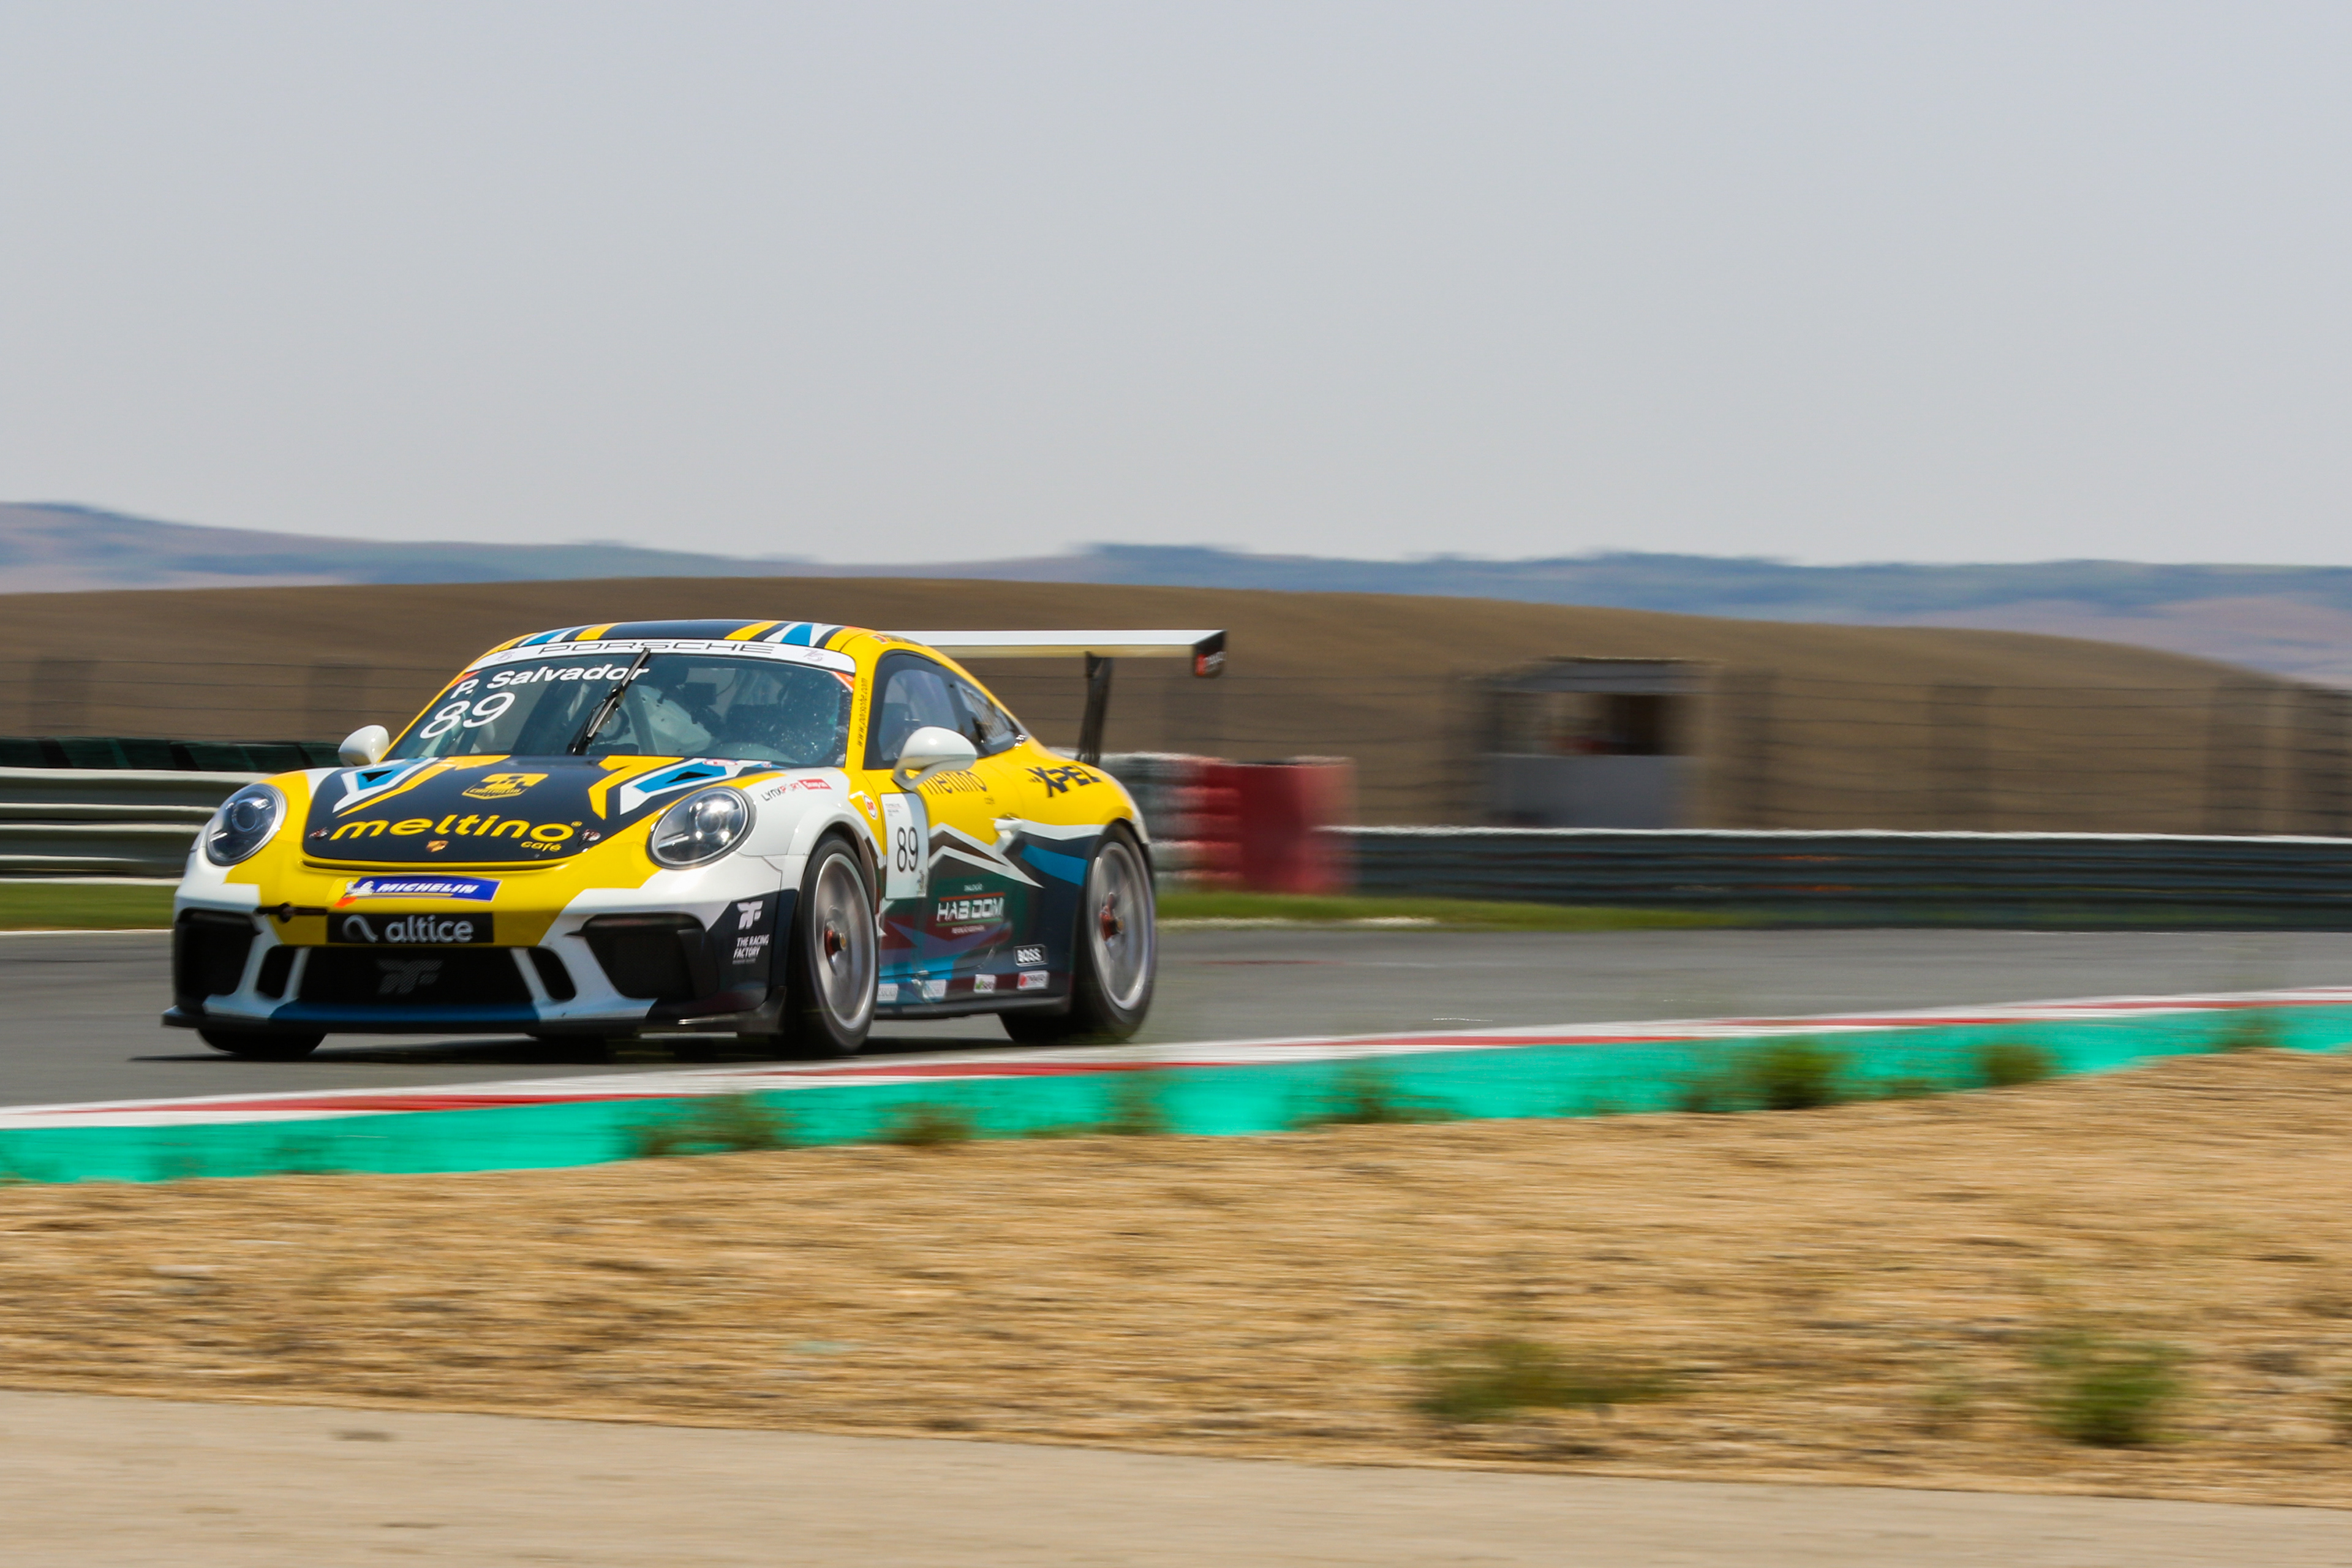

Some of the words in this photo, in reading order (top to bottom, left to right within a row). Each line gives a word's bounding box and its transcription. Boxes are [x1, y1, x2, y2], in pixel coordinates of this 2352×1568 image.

[538, 641, 774, 655] PORSCHE
[450, 679, 480, 699] P.
[487, 663, 650, 690] Salvador
[420, 692, 516, 739] 89
[1025, 764, 1103, 798] XPEL
[520, 840, 562, 853] café
[897, 826, 919, 872] 89
[375, 883, 480, 894] MICHELIN
[384, 914, 475, 944] altice
[736, 937, 749, 948] THE
[748, 933, 770, 947] RACING
[733, 946, 761, 960] FACTORY
